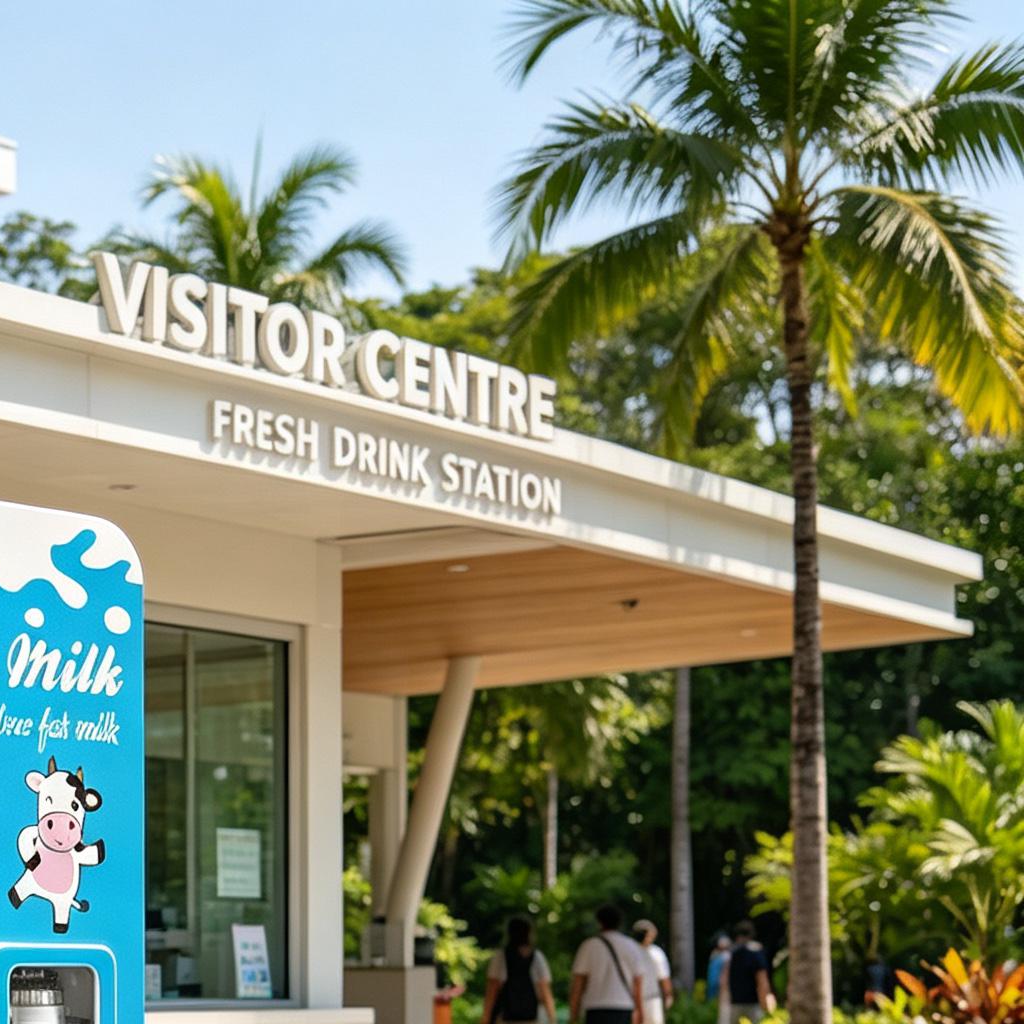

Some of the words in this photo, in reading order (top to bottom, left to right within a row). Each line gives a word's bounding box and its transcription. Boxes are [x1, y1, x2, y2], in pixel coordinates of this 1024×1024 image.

[92, 251, 346, 388] VISITOR
[357, 329, 557, 441] CENTRE
[211, 400, 318, 461] FRESH
[333, 428, 432, 487] DRINK
[441, 452, 561, 514] STATION
[7, 632, 123, 697] Milk
